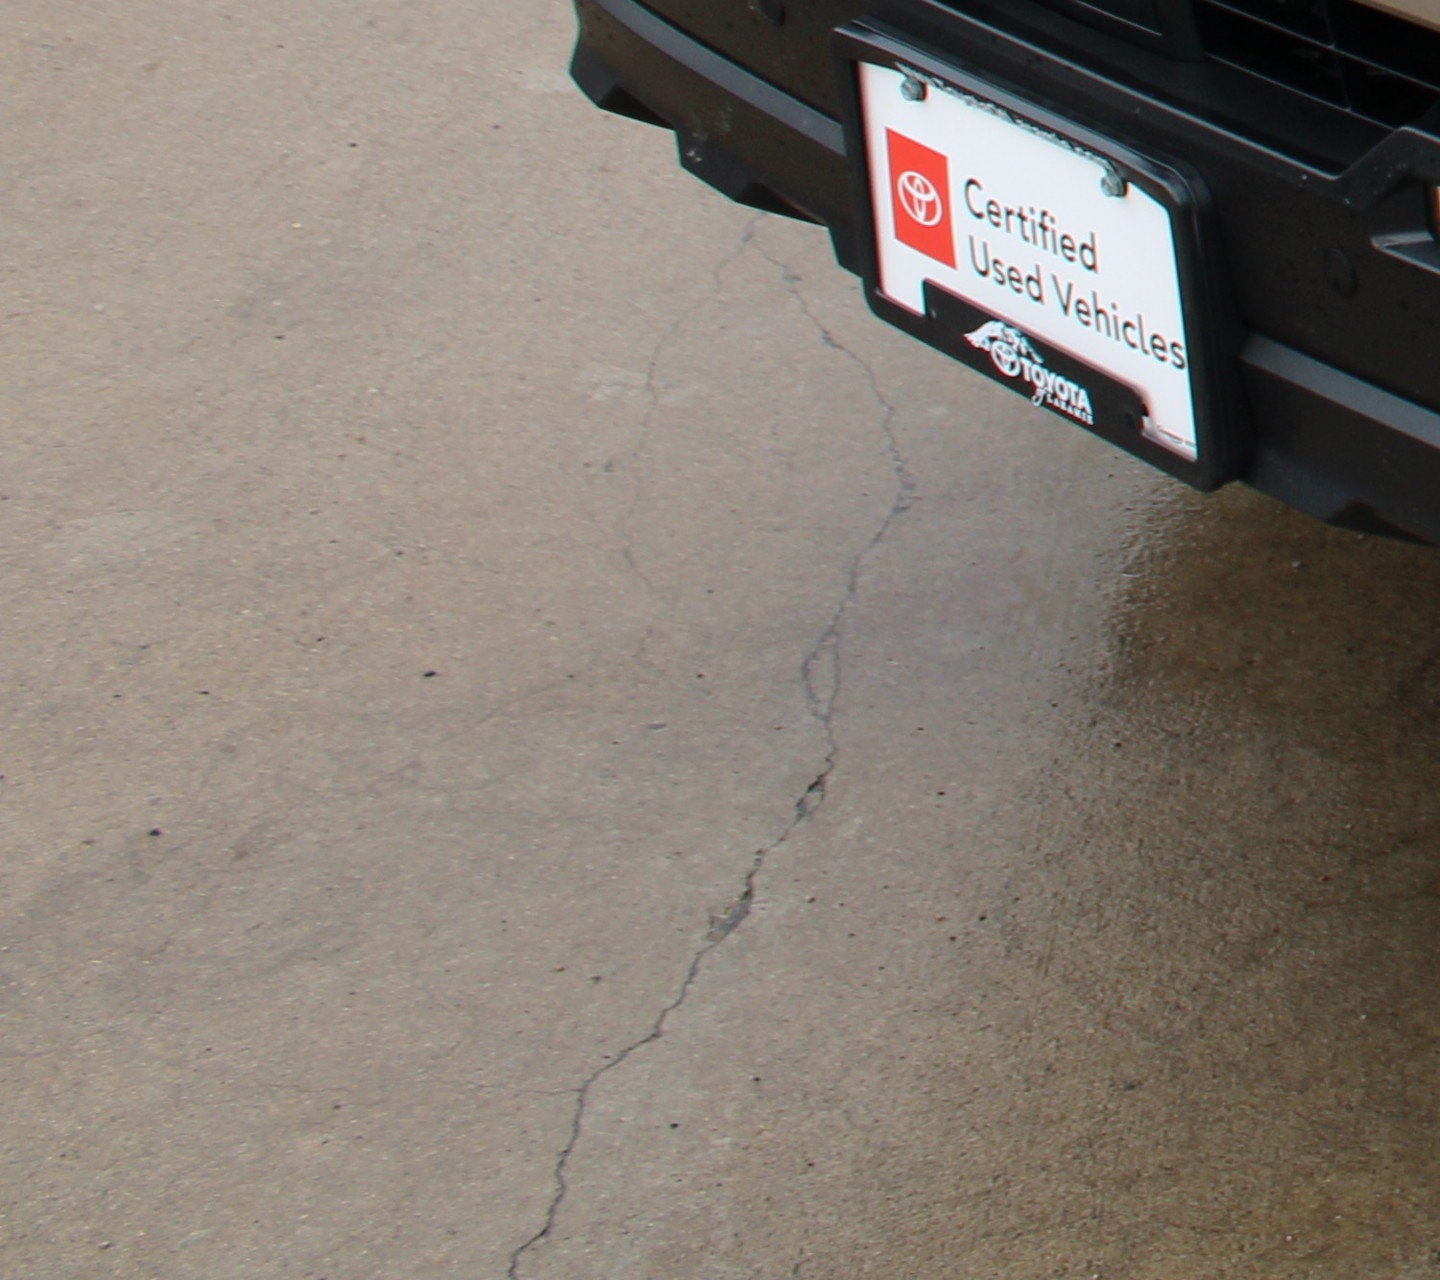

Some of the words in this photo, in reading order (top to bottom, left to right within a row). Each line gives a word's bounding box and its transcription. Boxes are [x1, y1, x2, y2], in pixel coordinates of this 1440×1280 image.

[964, 177, 1099, 274] Certified
[968, 234, 1045, 305] Used
[1052, 273, 1187, 371] Vehicles
[1021, 357, 1092, 414] TOYOTA
